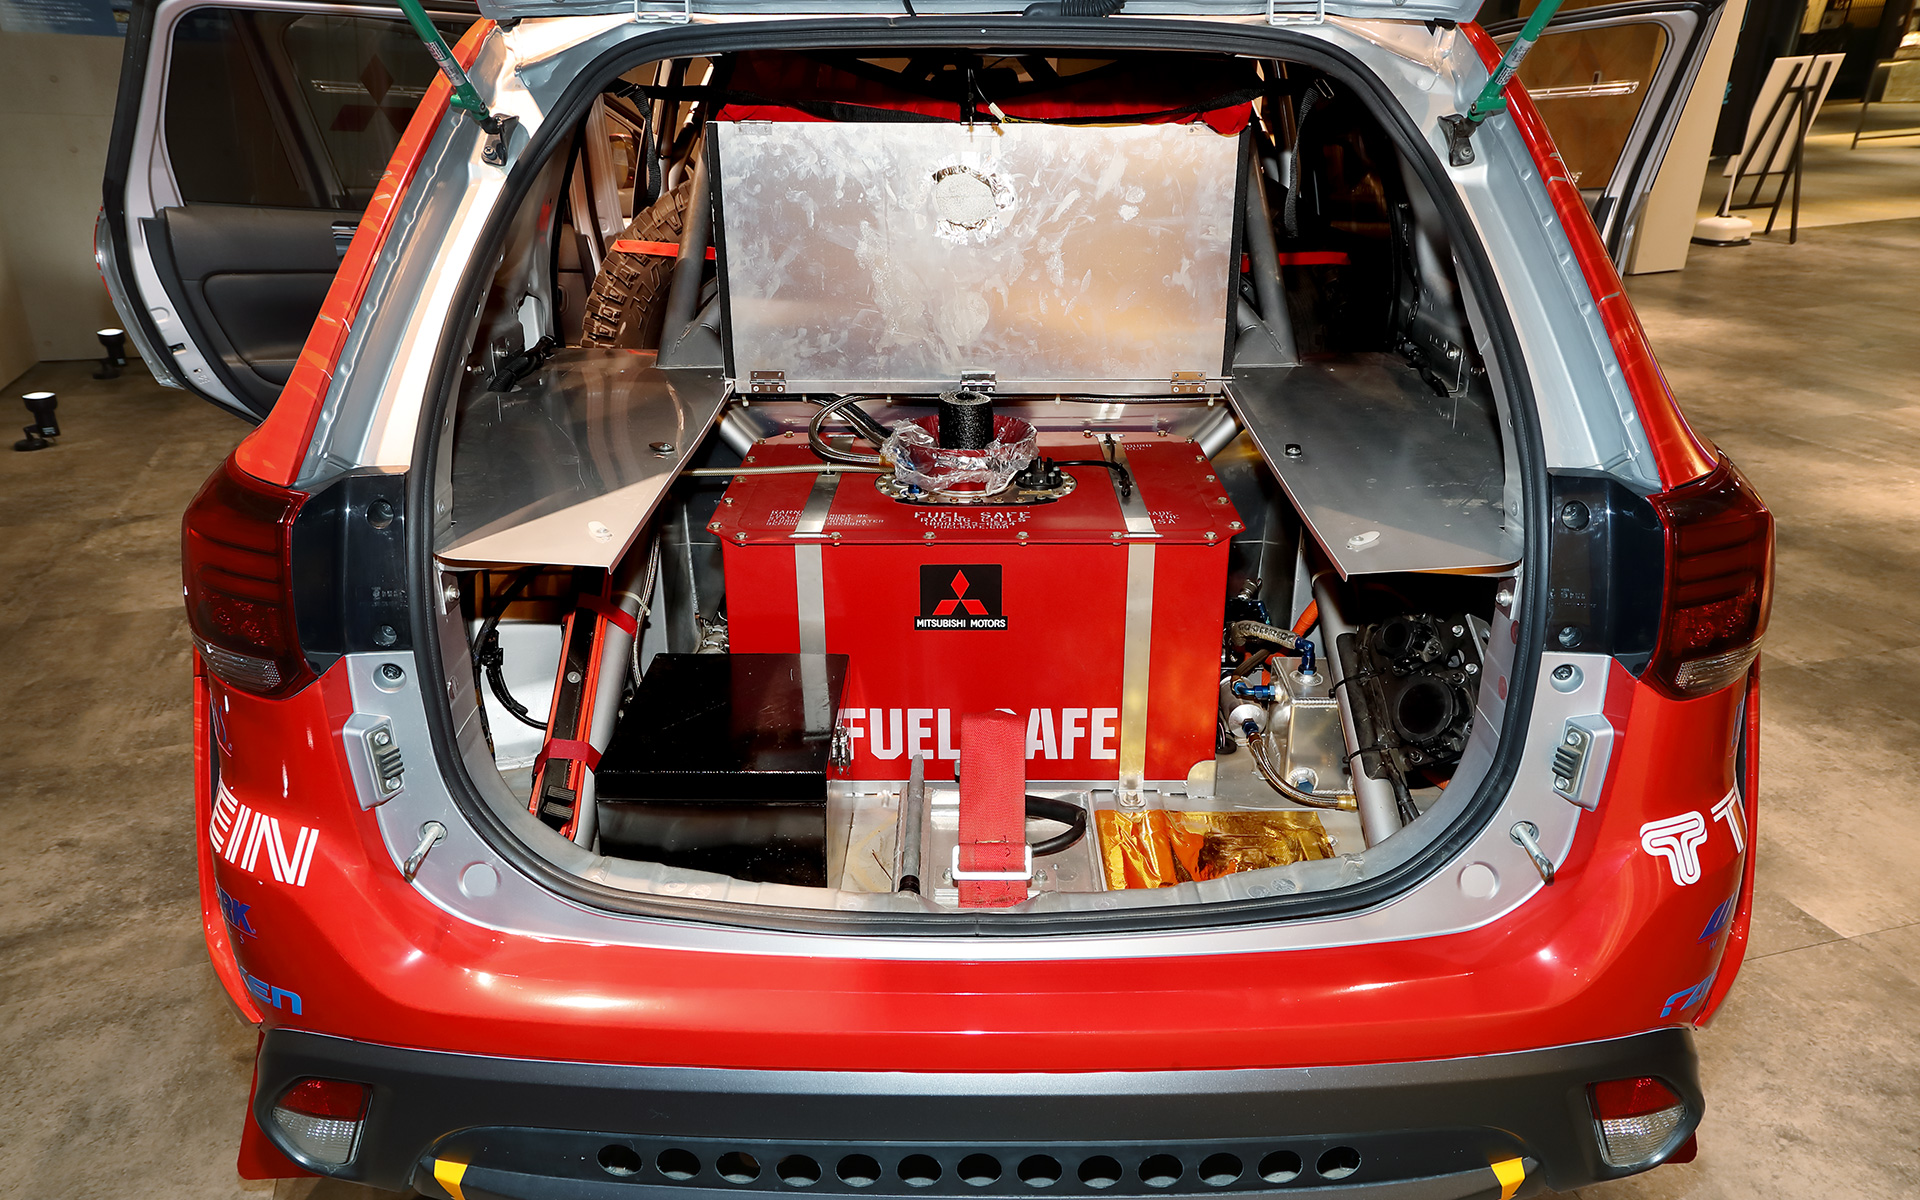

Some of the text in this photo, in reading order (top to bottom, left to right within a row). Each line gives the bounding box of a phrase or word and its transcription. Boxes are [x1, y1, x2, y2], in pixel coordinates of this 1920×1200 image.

[980, 511, 1031, 519] SAFE
[916, 619, 1006, 628] MITSUBISHI MOTORS
[838, 708, 1119, 760] FUEL AFE
[216, 878, 250, 934] RK
[1660, 968, 1719, 1018] FA
